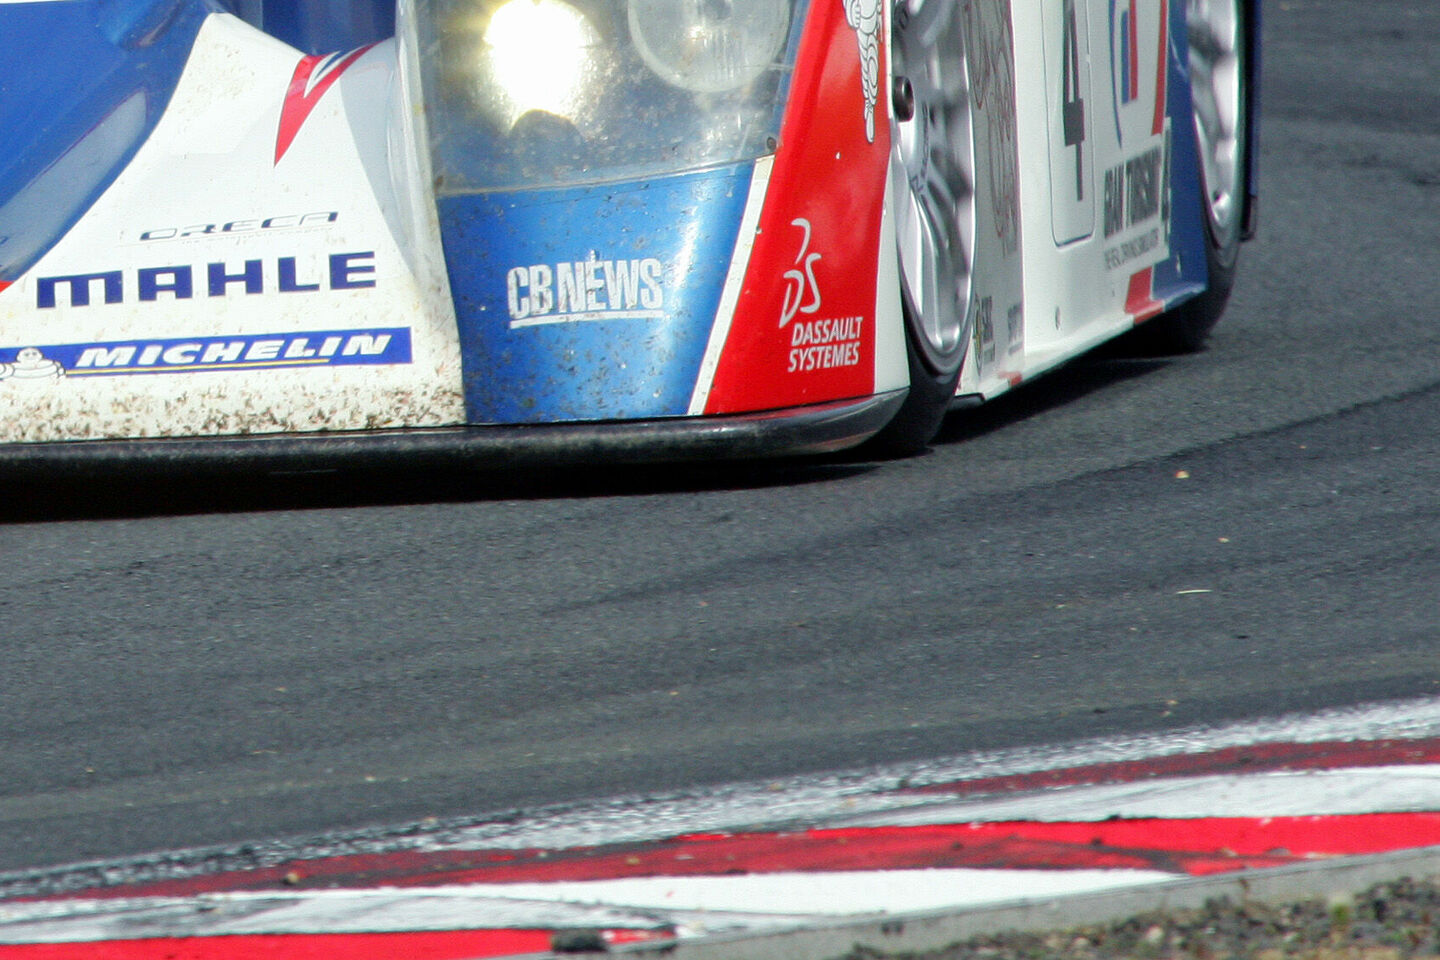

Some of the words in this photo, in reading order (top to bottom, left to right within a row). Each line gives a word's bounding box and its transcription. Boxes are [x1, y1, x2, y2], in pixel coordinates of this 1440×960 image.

[37, 251, 376, 309] MAHLE
[791, 316, 864, 347] DASSAULT
[75, 334, 392, 369] MICHELIN
[787, 342, 860, 373] SYSTEMES
